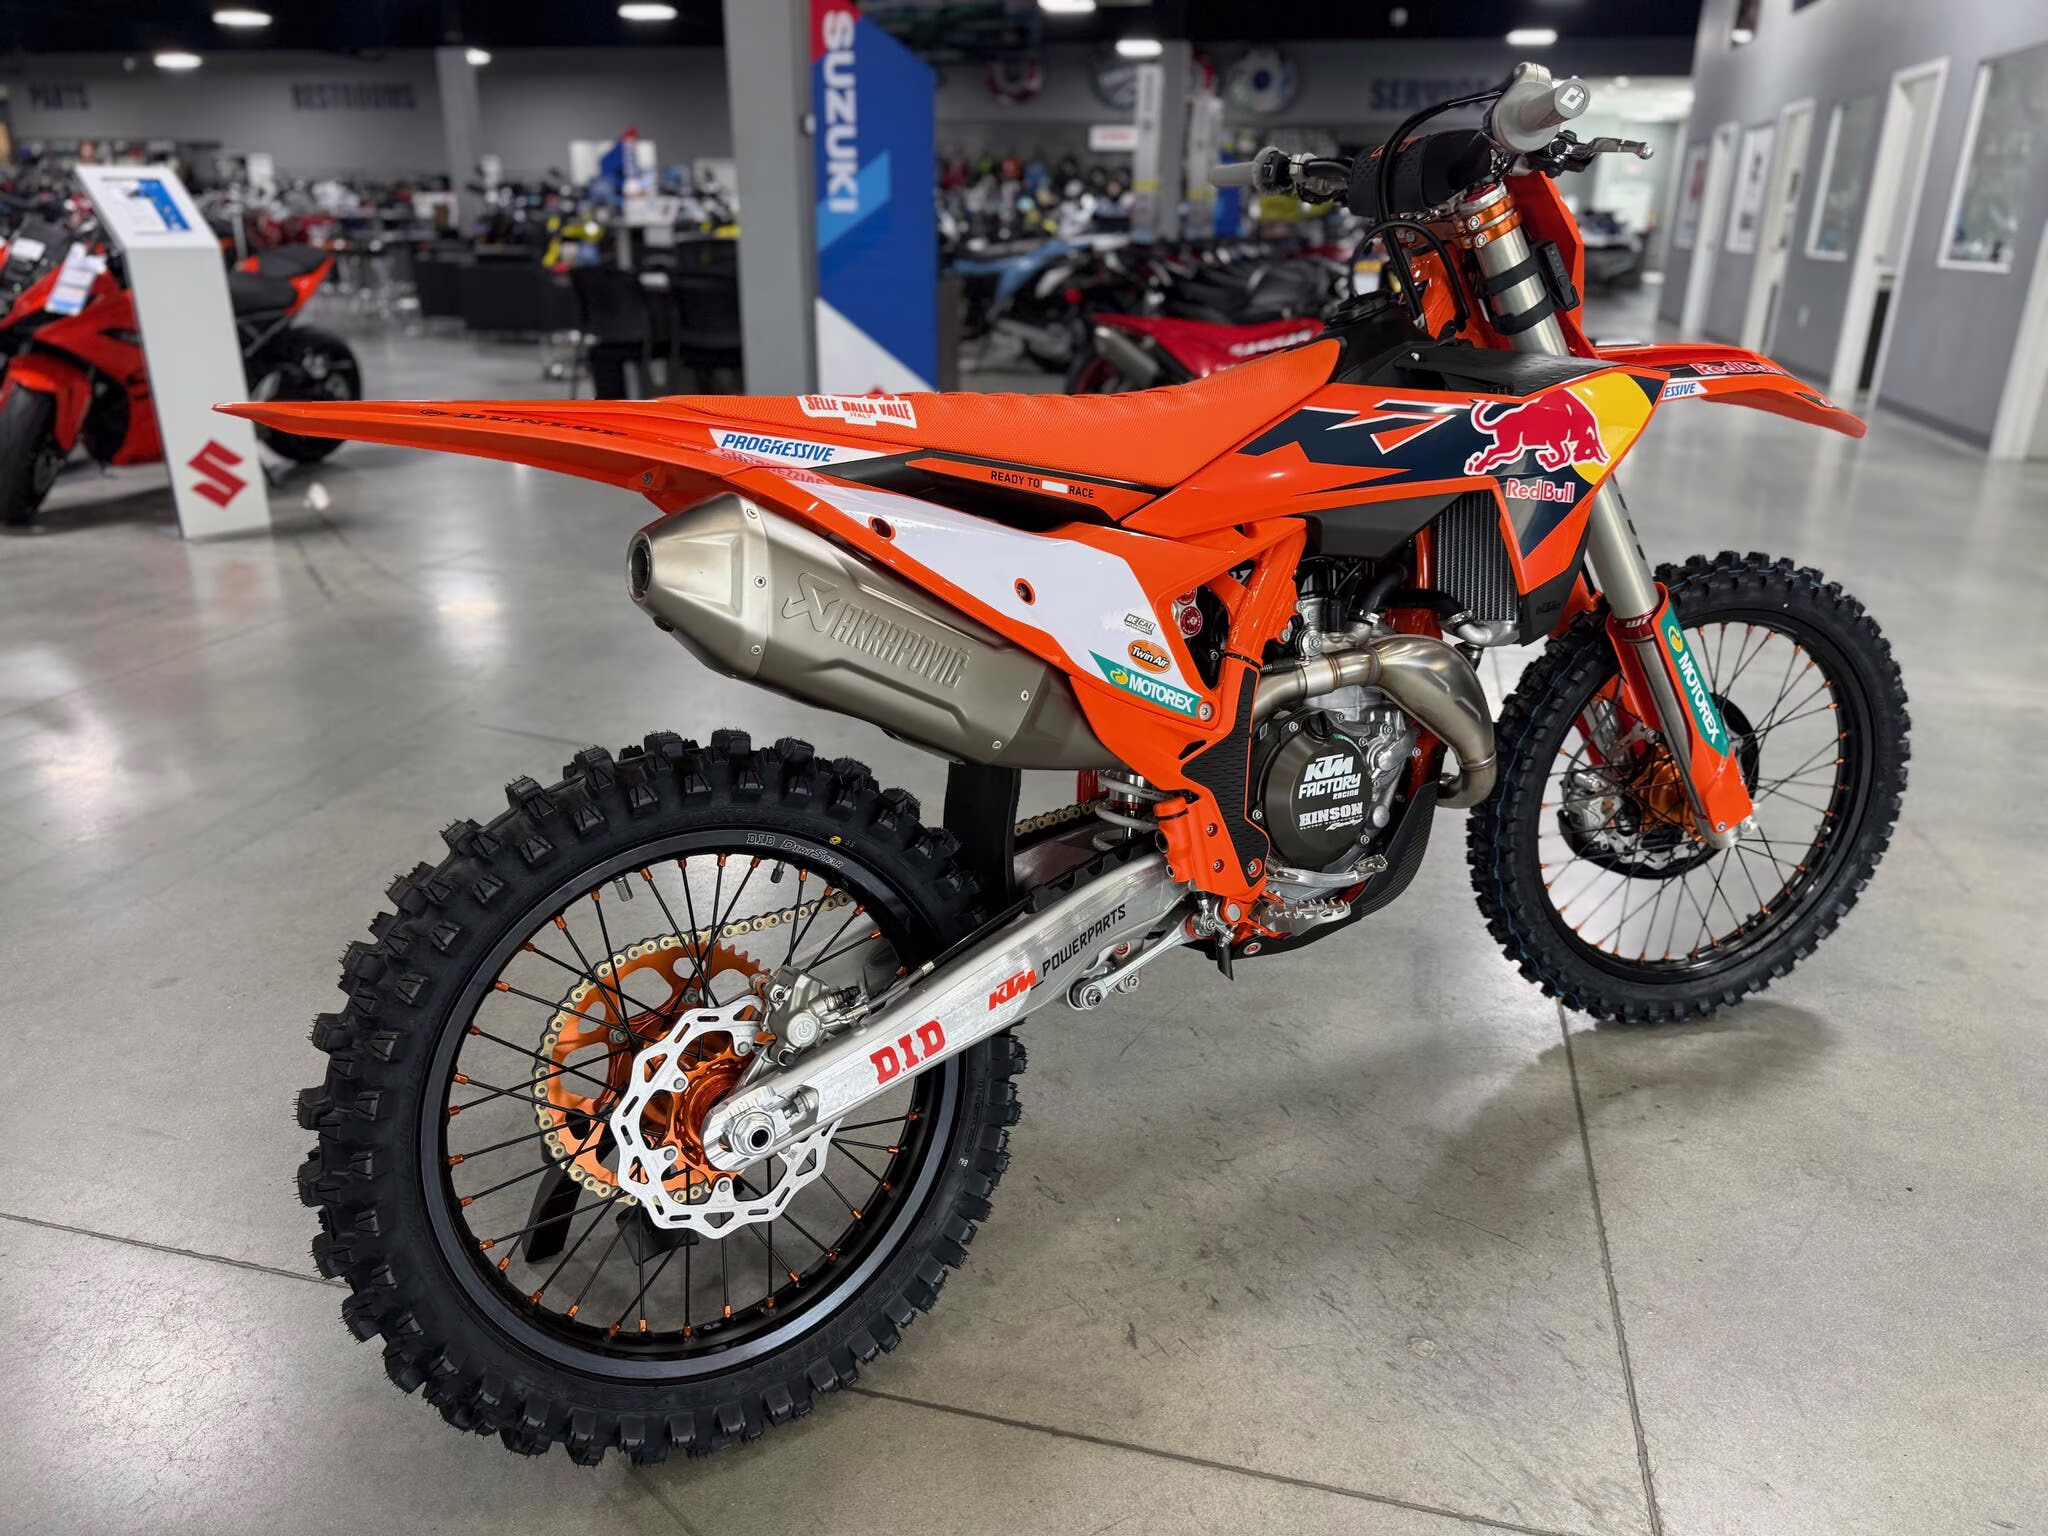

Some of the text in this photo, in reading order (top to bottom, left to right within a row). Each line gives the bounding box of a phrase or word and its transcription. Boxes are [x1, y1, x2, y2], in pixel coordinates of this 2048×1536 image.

[822, 10, 858, 213] SUZUKI
[804, 395, 911, 420] SELLE DALLA VALLE
[455, 412, 629, 437] DUNLOP
[720, 433, 835, 463] PROGRESSIVE
[990, 470, 1095, 499] READY TO RACE
[1506, 478, 1575, 503] Red Bull
[1132, 645, 1169, 668] Twin Air
[1129, 674, 1194, 712] MOTOREX
[1678, 651, 1720, 744] MOTOREX
[1304, 753, 1354, 783] KTM
[1298, 773, 1361, 799] FACTORY
[1299, 802, 1363, 827] HINSON
[988, 903, 1126, 1011] KTM POWERPARTS
